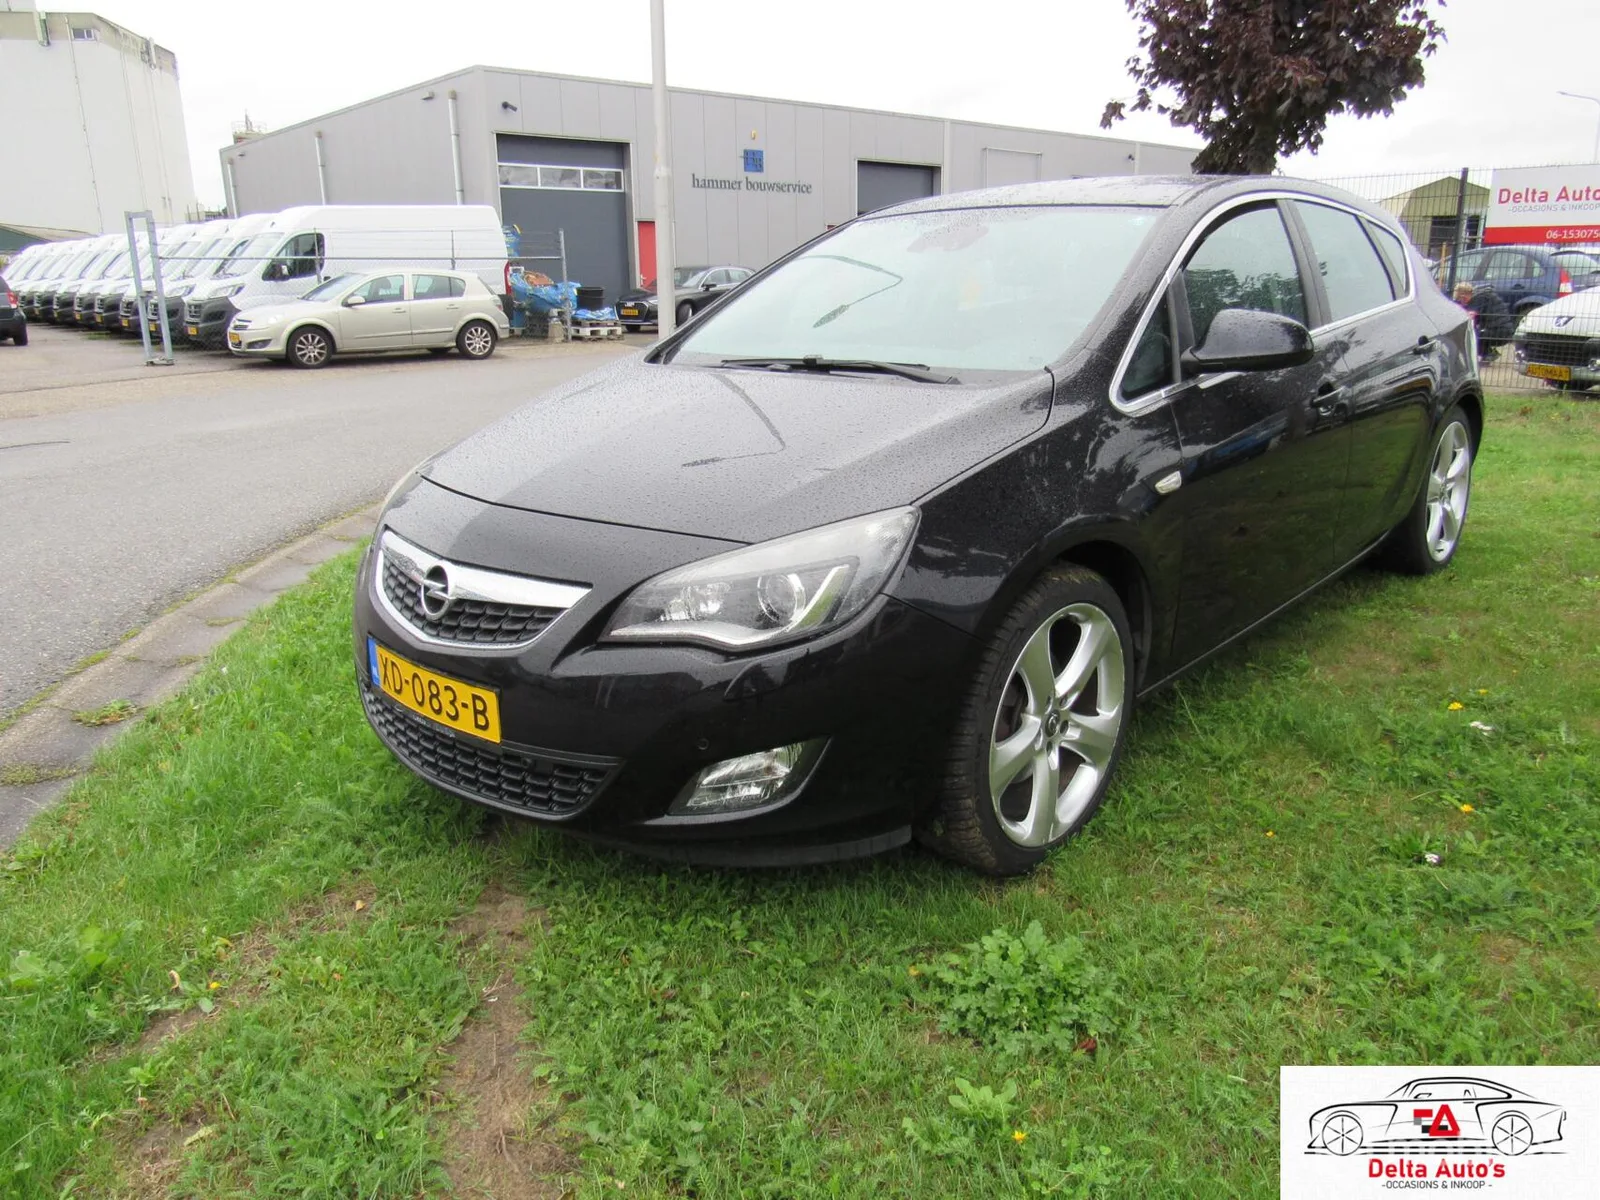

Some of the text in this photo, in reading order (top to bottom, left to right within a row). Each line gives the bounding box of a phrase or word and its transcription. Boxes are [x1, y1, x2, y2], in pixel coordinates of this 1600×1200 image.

[692, 173, 812, 194] hammer bouwservice
[1498, 187, 1549, 205] Delta
[1546, 229, 1600, 239] 06-153075
[380, 654, 490, 731] XD-083-B
